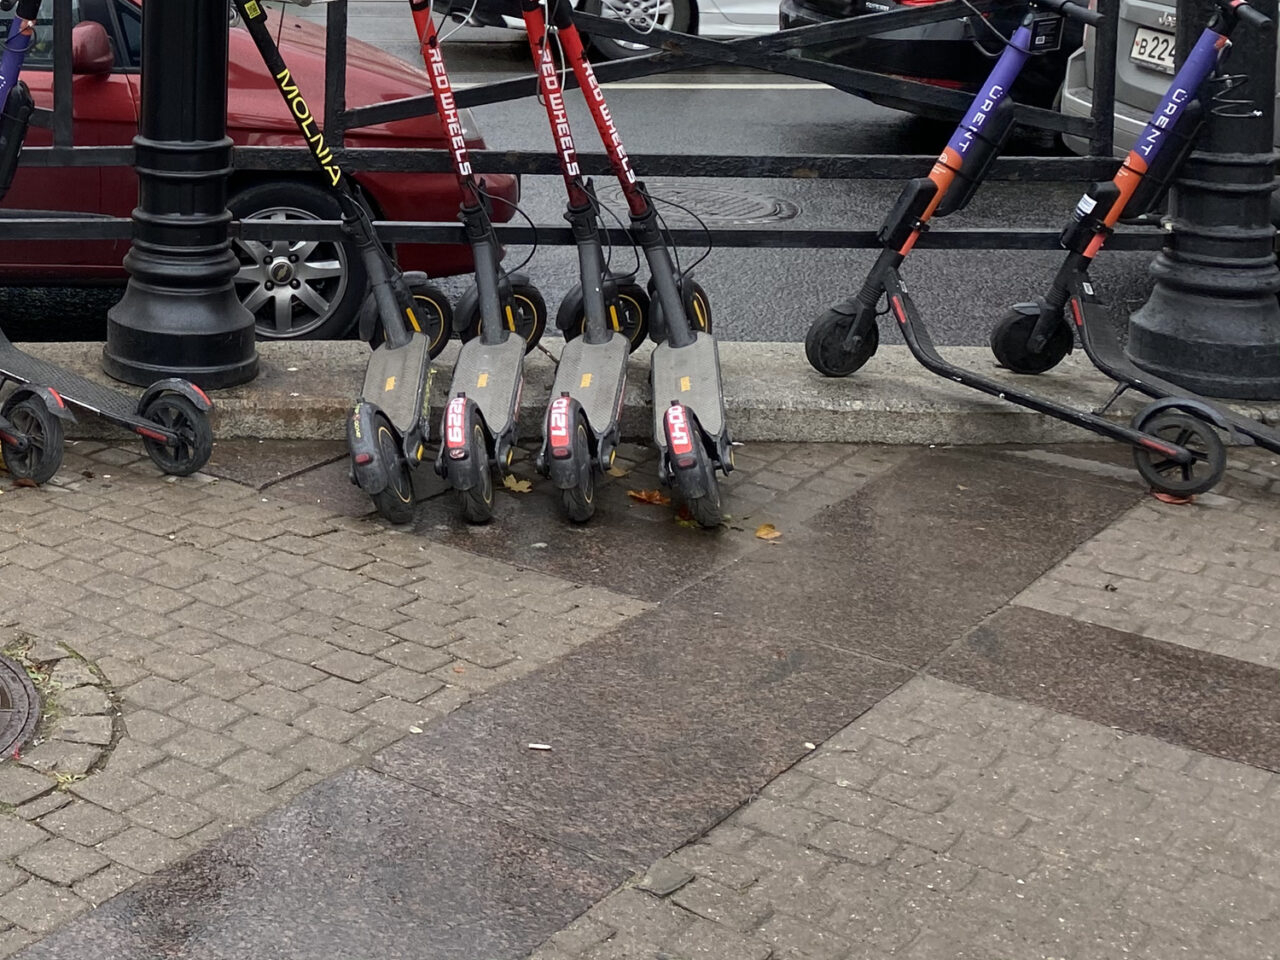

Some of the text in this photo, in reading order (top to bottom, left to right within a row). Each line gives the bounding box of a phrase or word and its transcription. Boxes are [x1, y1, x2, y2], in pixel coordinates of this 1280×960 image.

[277, 69, 341, 187] MOLNIA
[428, 48, 472, 176] RED WHEELS
[537, 48, 580, 176] RED WHEELS
[582, 59, 636, 184] RED WHEELS
[447, 396, 465, 443] 0229
[550, 398, 568, 437] 0121
[667, 404, 688, 446] 0041
